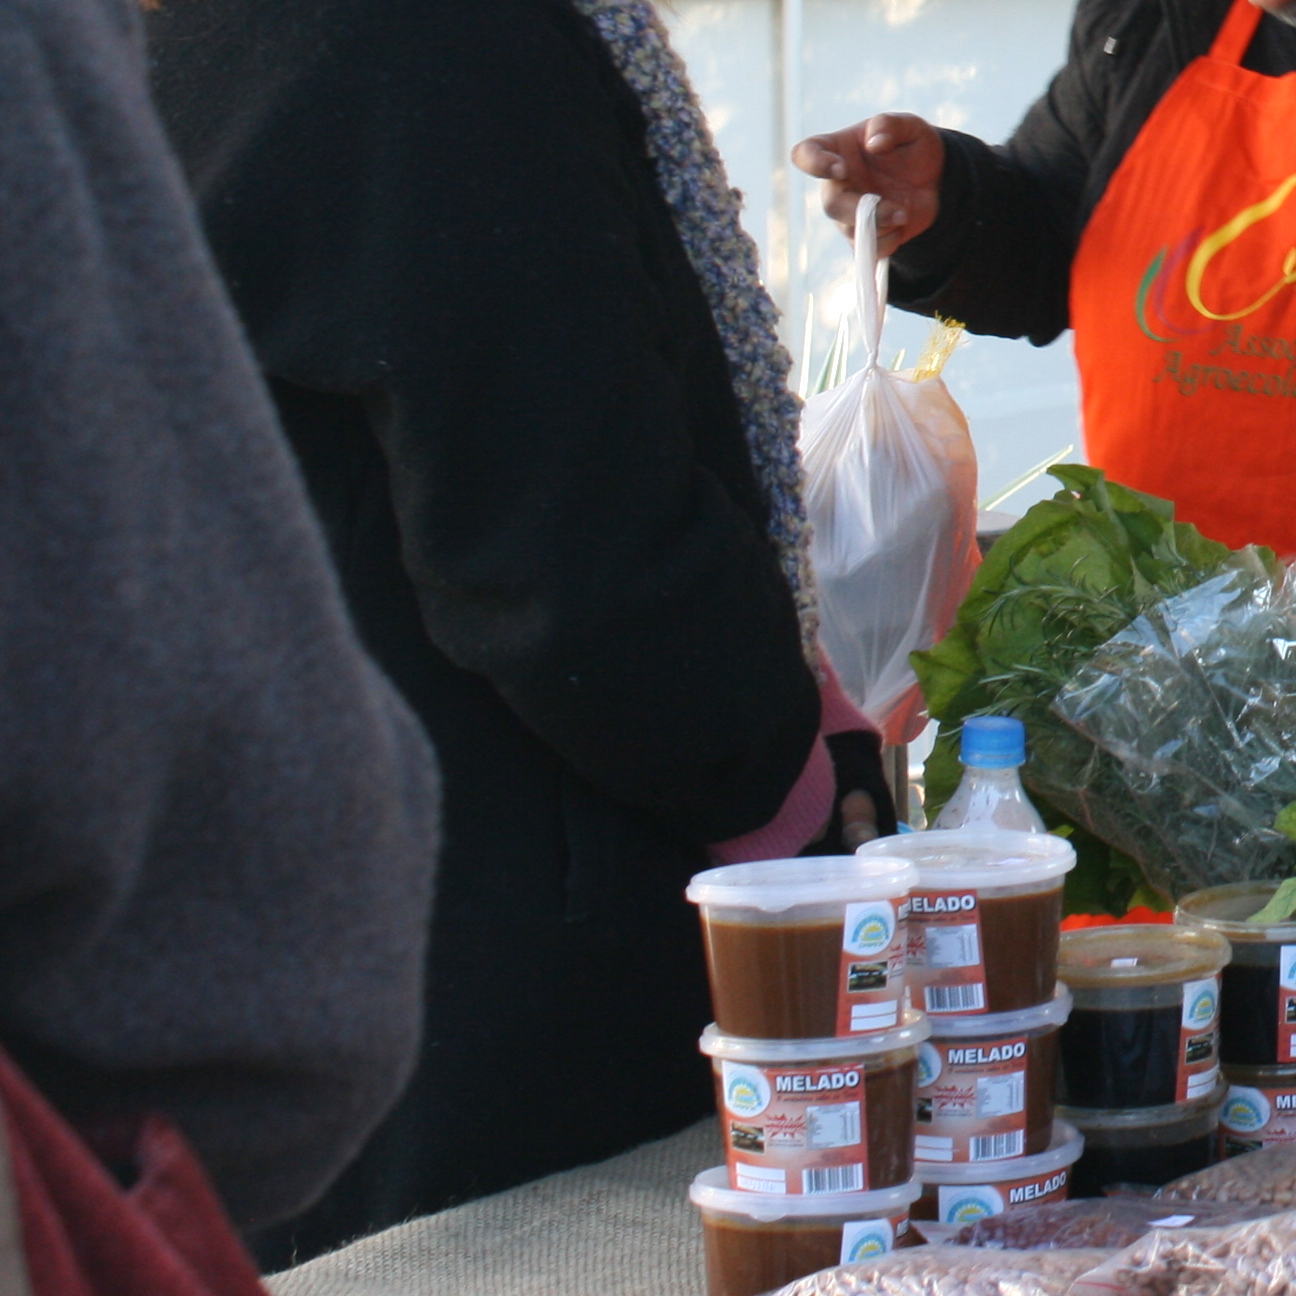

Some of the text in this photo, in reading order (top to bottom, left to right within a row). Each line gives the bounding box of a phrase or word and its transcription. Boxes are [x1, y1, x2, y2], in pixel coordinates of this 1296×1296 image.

[908, 894, 976, 913] ELADO
[948, 1042, 1027, 1065] MELADO
[775, 1070, 861, 1093] MELADO
[1009, 1171, 1068, 1204] MELADO
